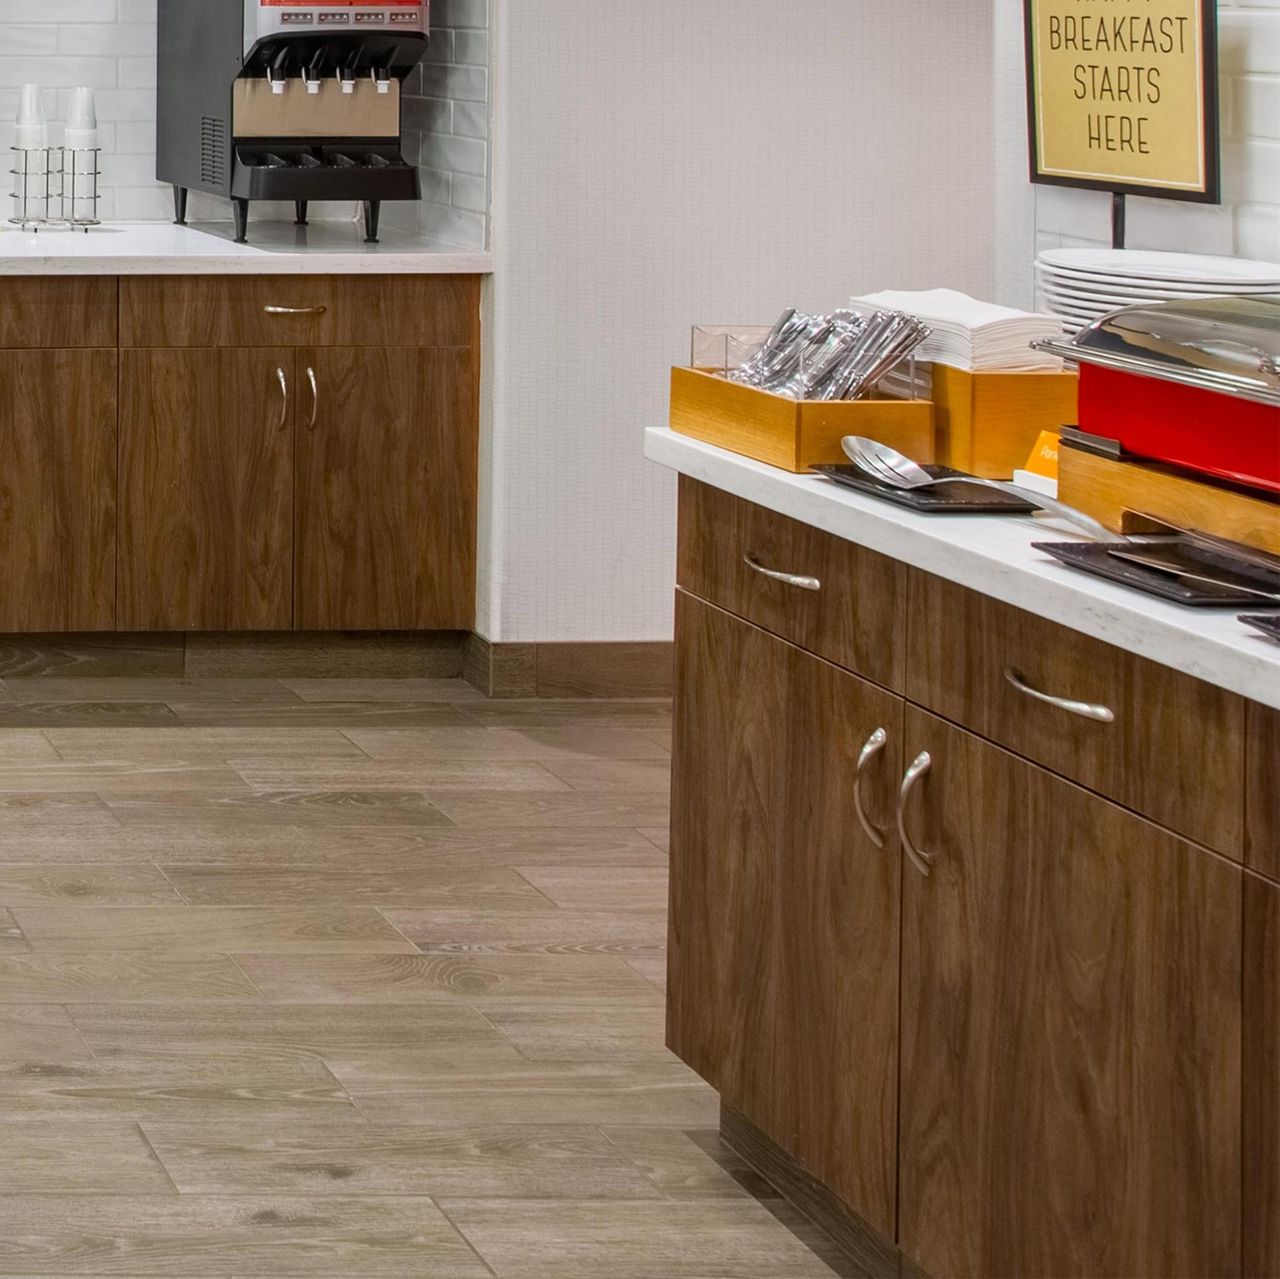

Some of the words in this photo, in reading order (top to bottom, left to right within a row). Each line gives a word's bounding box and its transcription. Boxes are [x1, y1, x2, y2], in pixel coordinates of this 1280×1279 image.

[1049, 15, 1188, 53] BREAKFAST
[1073, 64, 1160, 104] STARTS
[1088, 114, 1150, 154] HERE
